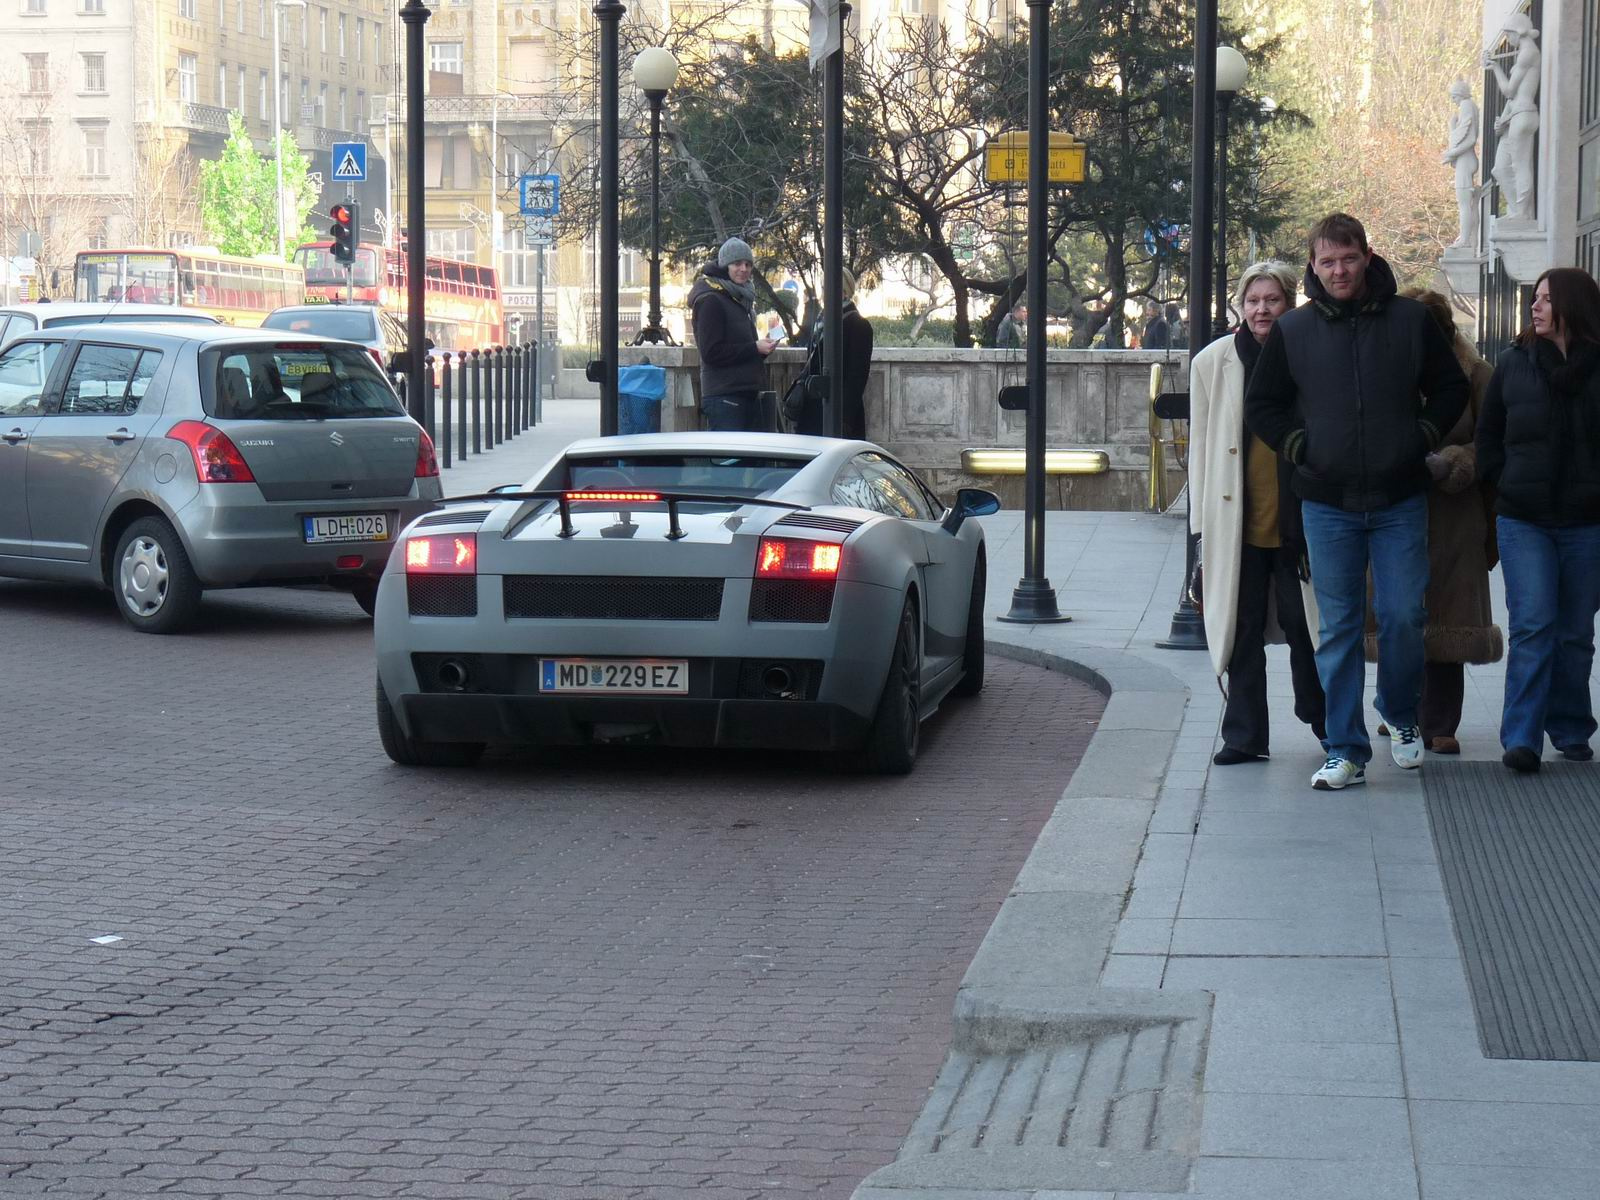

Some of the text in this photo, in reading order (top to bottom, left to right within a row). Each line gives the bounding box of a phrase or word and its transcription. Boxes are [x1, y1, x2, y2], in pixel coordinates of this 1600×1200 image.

[508, 296, 546, 305] POSZTR
[560, 664, 588, 687] MD
[605, 664, 647, 687] 229
[652, 665, 679, 687] EZ
